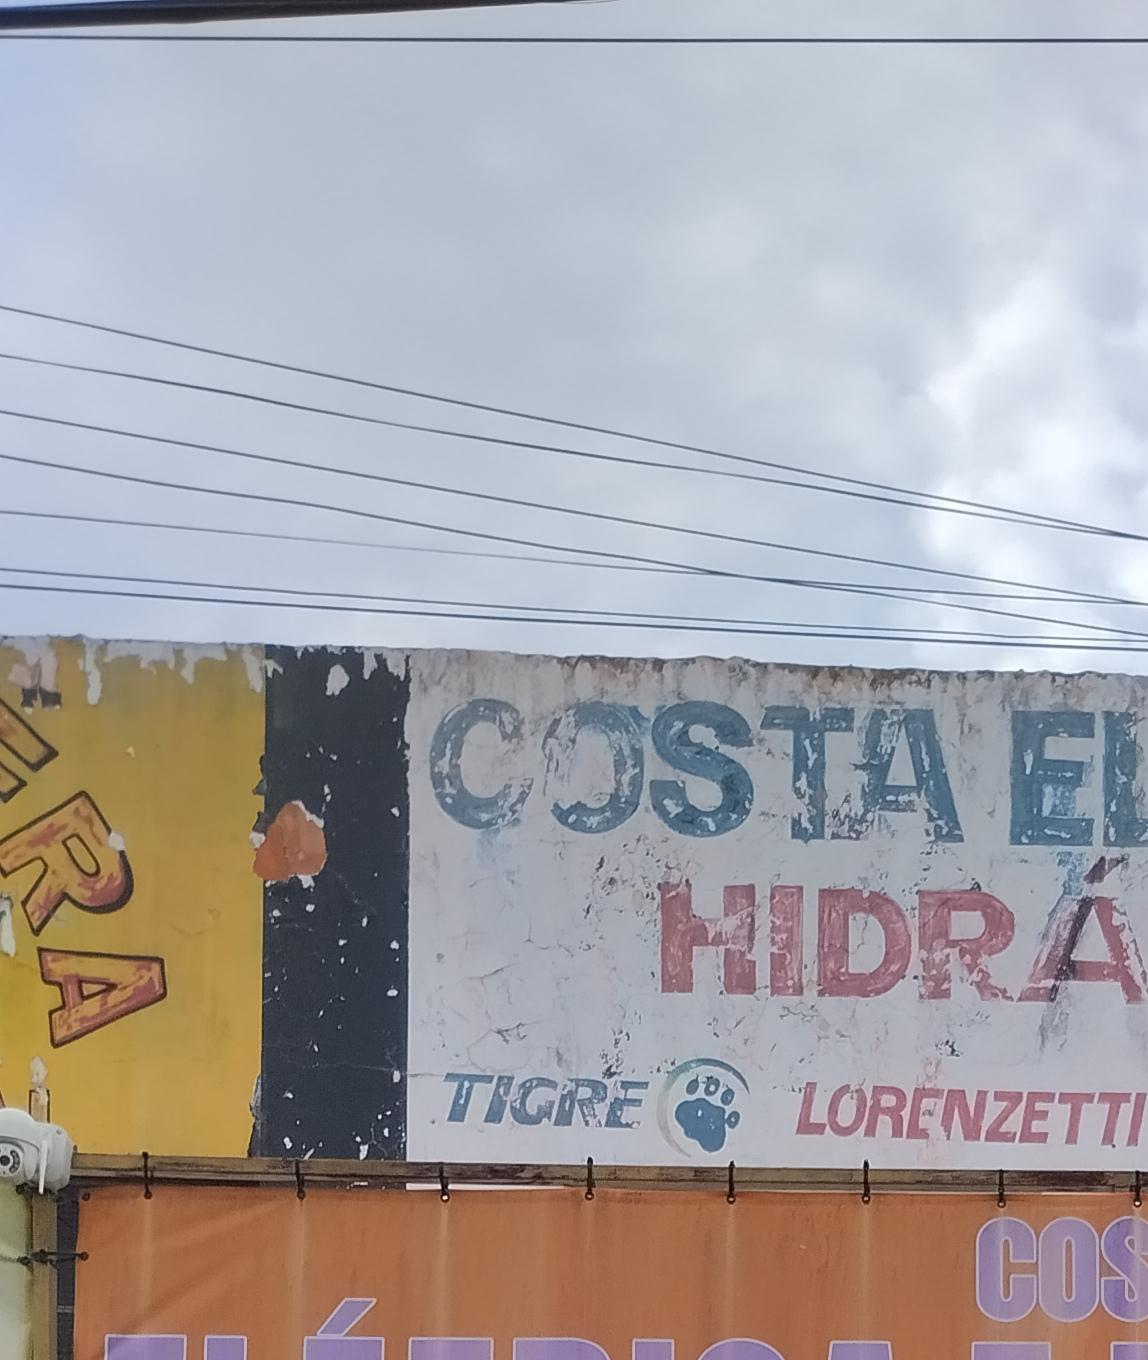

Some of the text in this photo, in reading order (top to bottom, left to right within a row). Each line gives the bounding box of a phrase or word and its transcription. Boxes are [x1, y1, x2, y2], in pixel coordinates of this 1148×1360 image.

[430, 699, 964, 843] COSTA
[442, 1072, 650, 1130] TIGRE
[795, 1082, 1146, 1147] LORENZETTI
